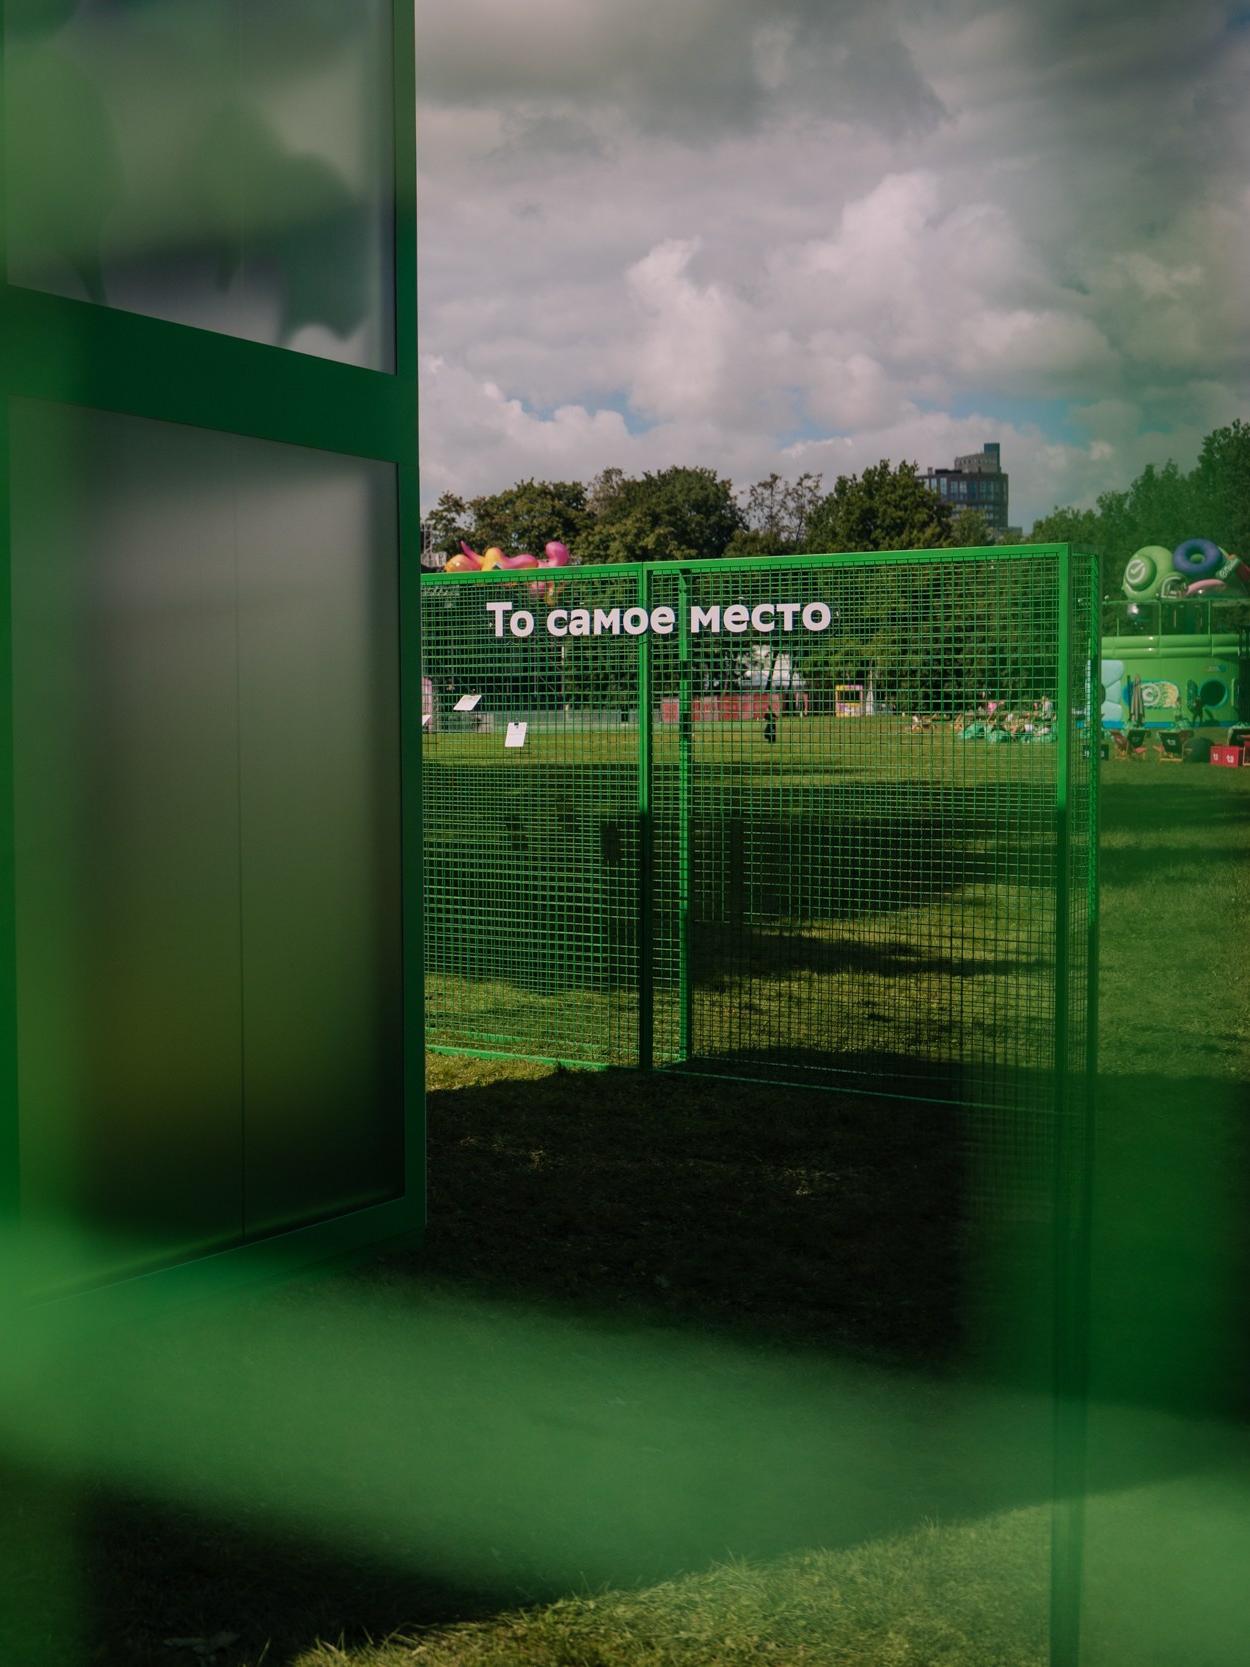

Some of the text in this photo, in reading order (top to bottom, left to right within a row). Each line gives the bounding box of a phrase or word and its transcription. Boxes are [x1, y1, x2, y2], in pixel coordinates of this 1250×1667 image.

[486, 600, 831, 637] То самое место
